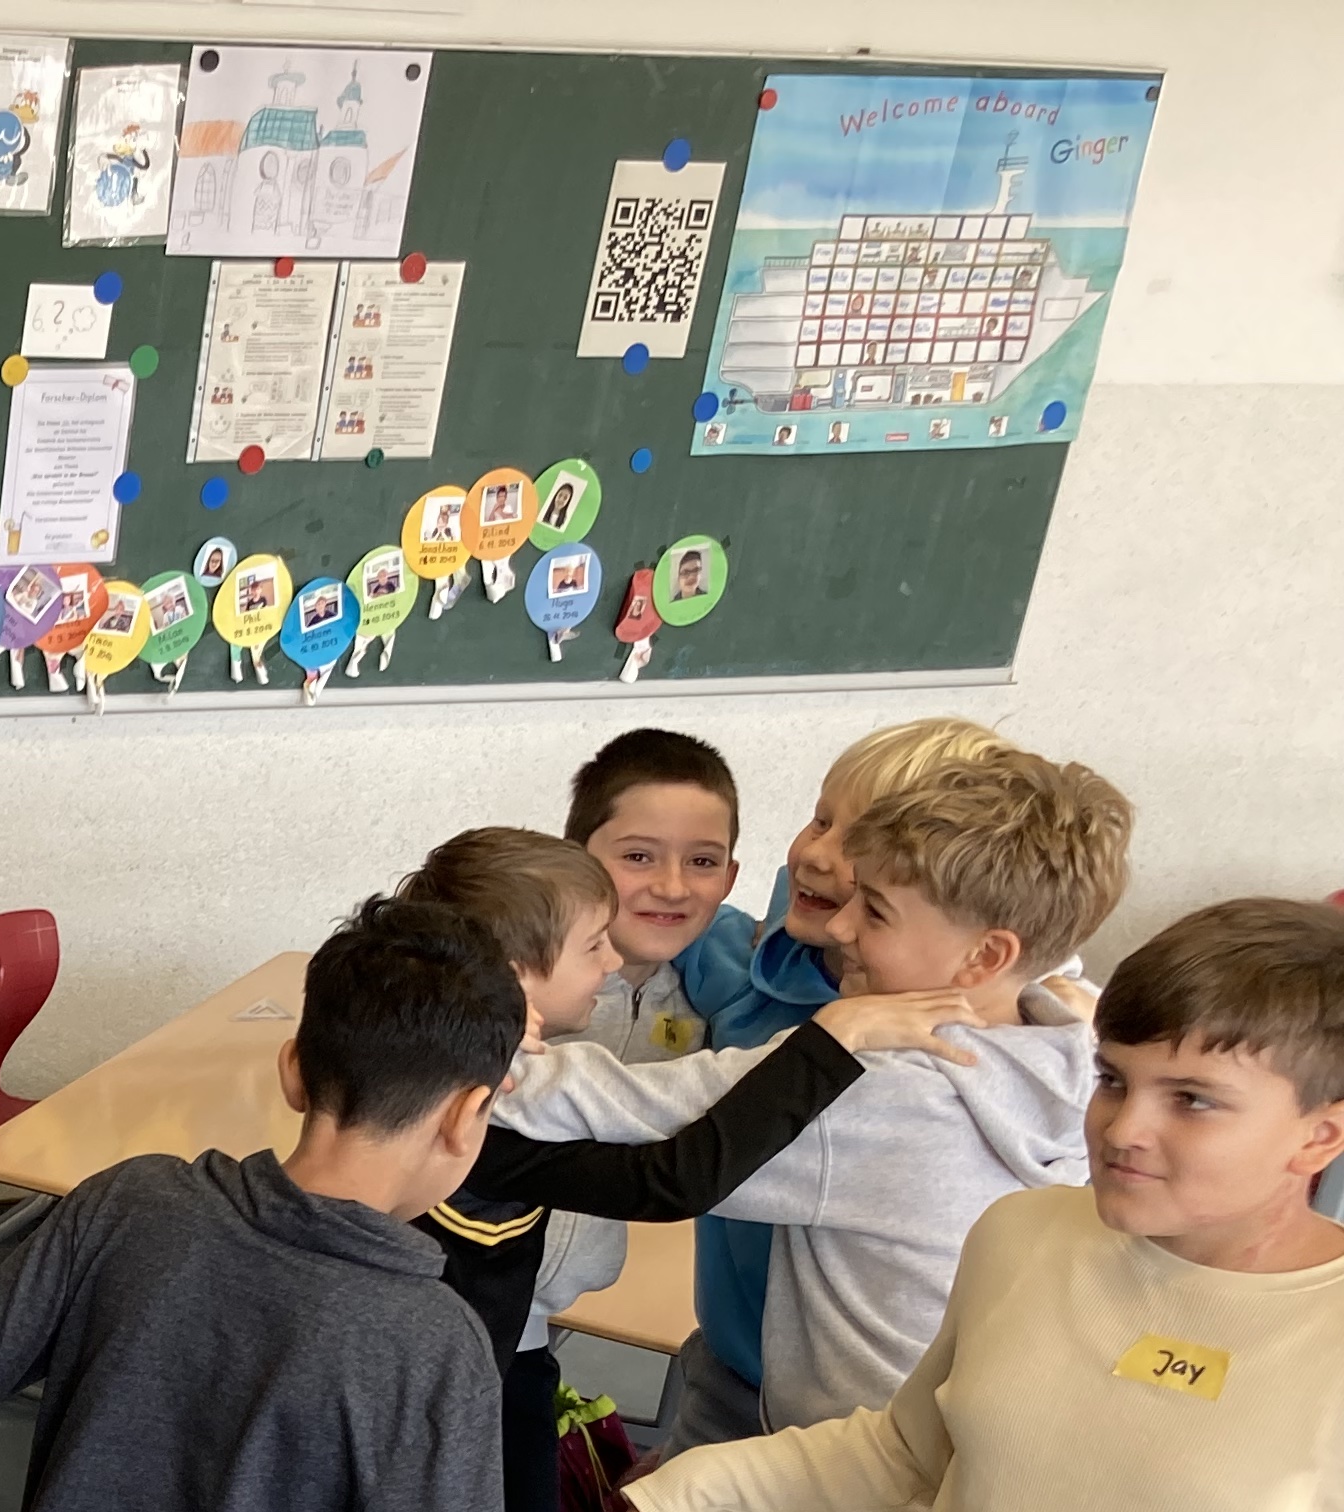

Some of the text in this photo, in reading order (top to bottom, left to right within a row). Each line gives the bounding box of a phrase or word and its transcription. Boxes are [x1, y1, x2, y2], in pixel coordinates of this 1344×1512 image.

[840, 90, 1061, 138] Welcome aboard
[1050, 134, 1129, 165] Ginger
[41, 392, 108, 403] Forscher-Diplom
[243, 612, 262, 625] Phil
[1152, 1349, 1206, 1386] Jay
